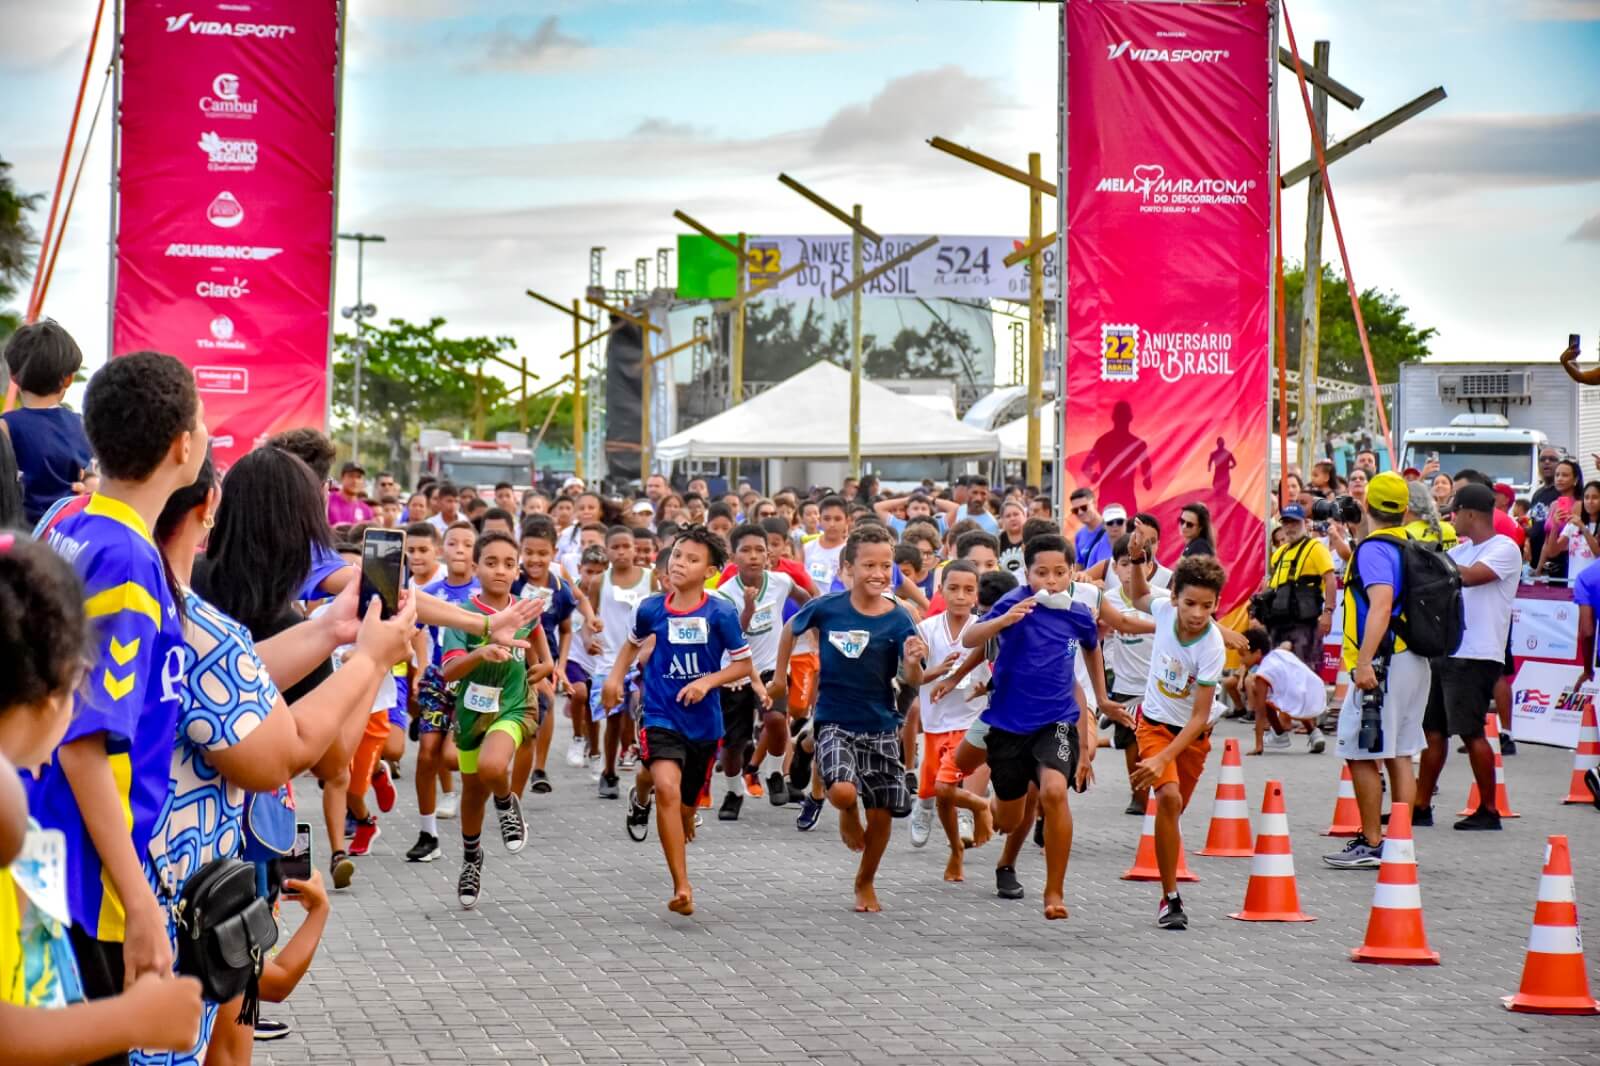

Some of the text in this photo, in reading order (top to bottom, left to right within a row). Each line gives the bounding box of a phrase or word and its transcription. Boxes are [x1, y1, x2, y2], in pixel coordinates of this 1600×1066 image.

[1153, 194, 1169, 204] DO
[936, 246, 991, 274] 524
[196, 280, 242, 299] Claro
[1105, 335, 1136, 360] 22
[1141, 347, 1235, 383] DO BRASIL
[678, 628, 698, 640] 567
